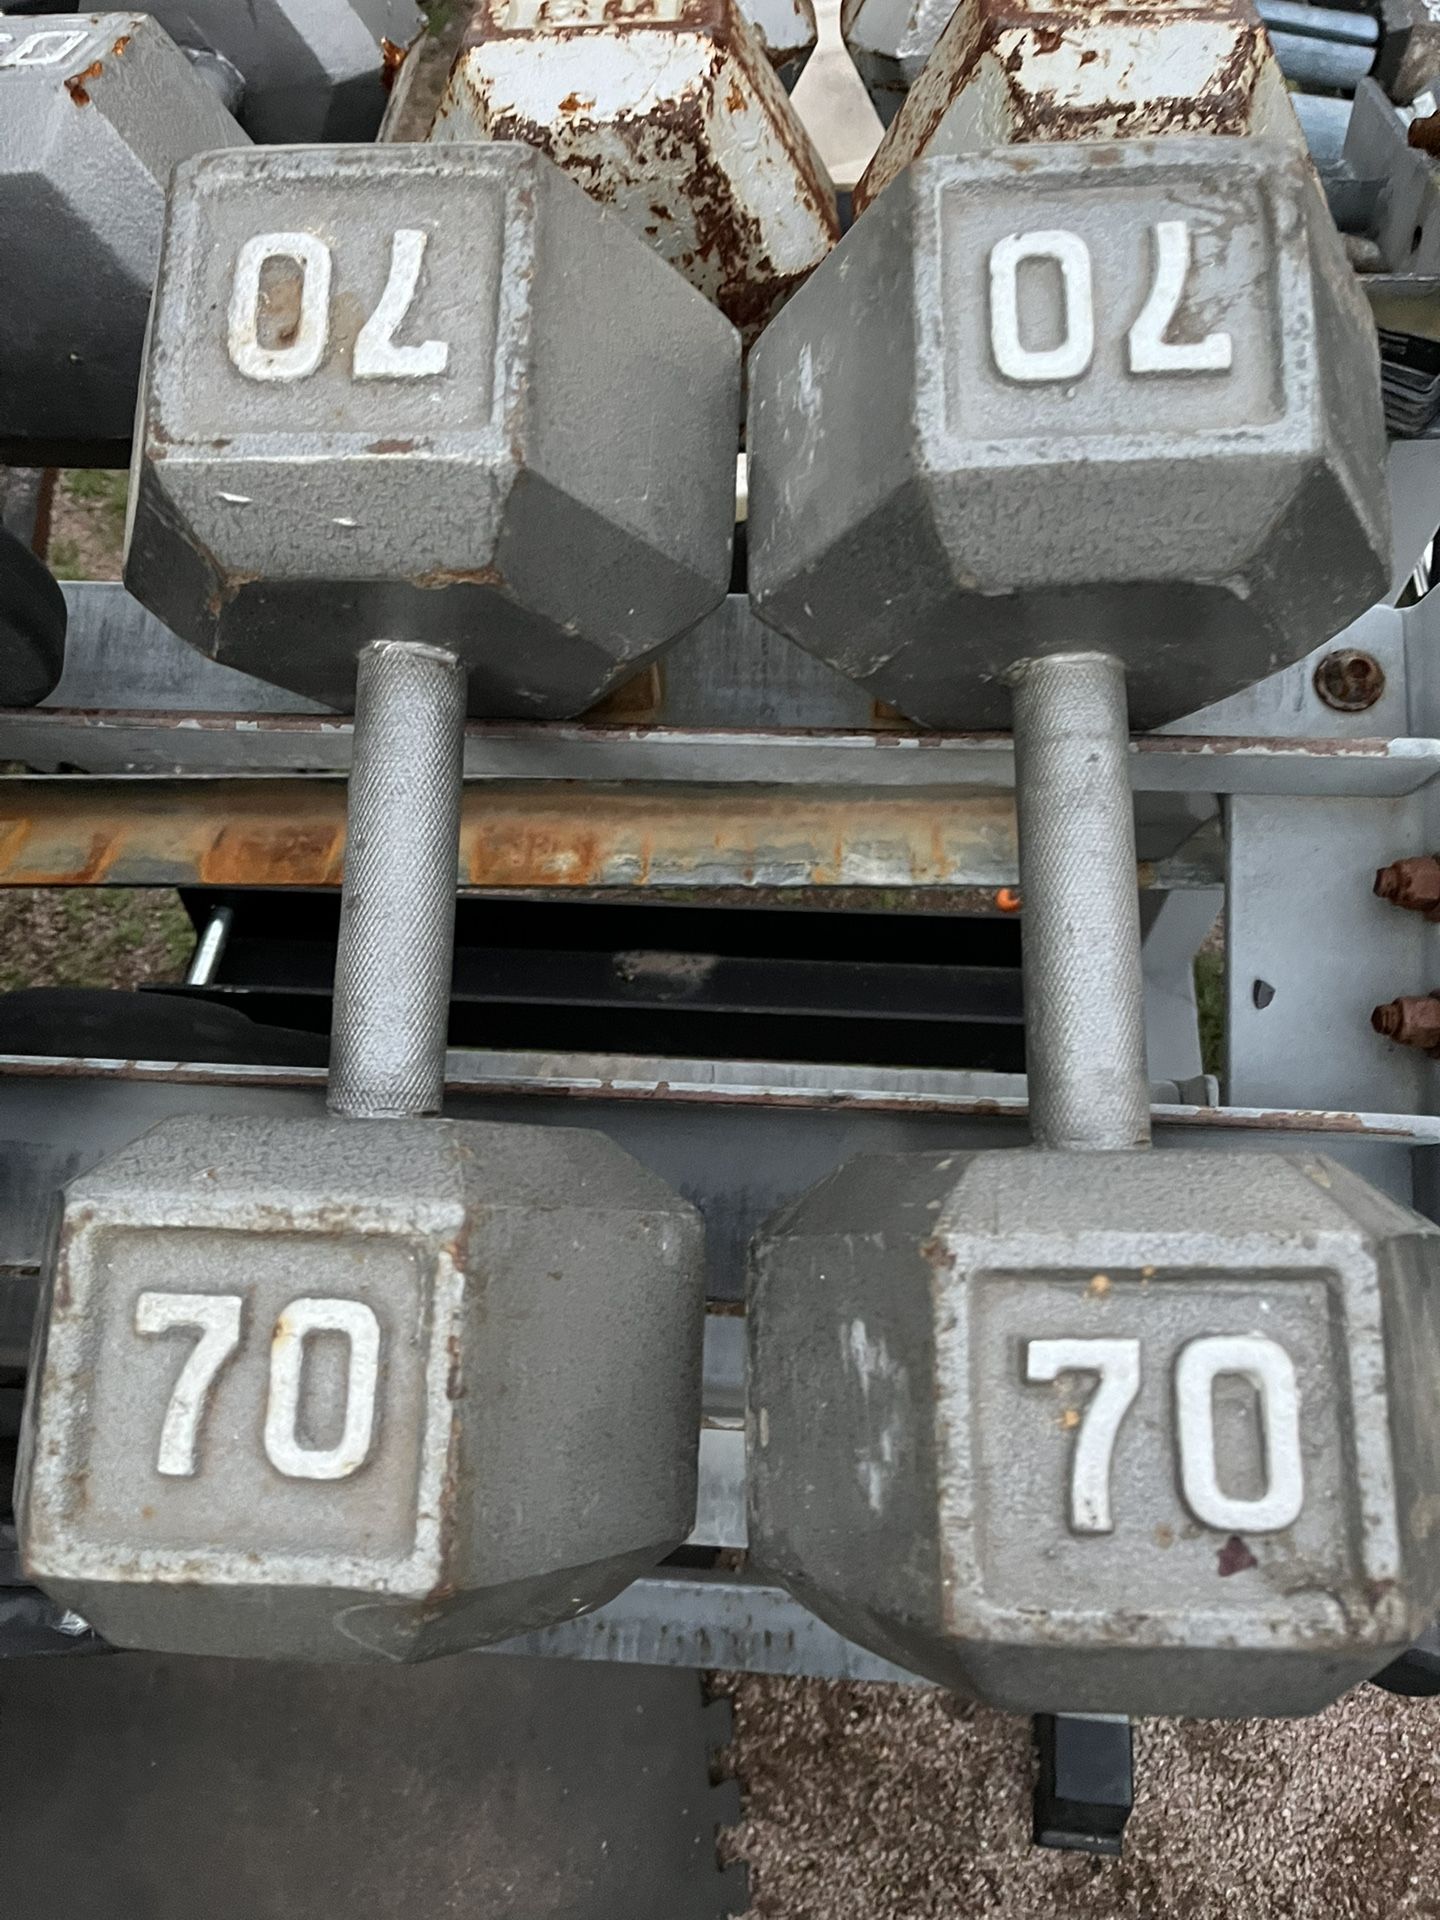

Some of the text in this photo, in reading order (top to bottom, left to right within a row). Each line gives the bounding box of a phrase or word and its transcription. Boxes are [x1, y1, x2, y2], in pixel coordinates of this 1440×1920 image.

[228, 229, 448, 381] 70
[990, 221, 1231, 380] 70
[136, 1292, 380, 1480] 70
[1027, 1334, 1303, 1532] 70
